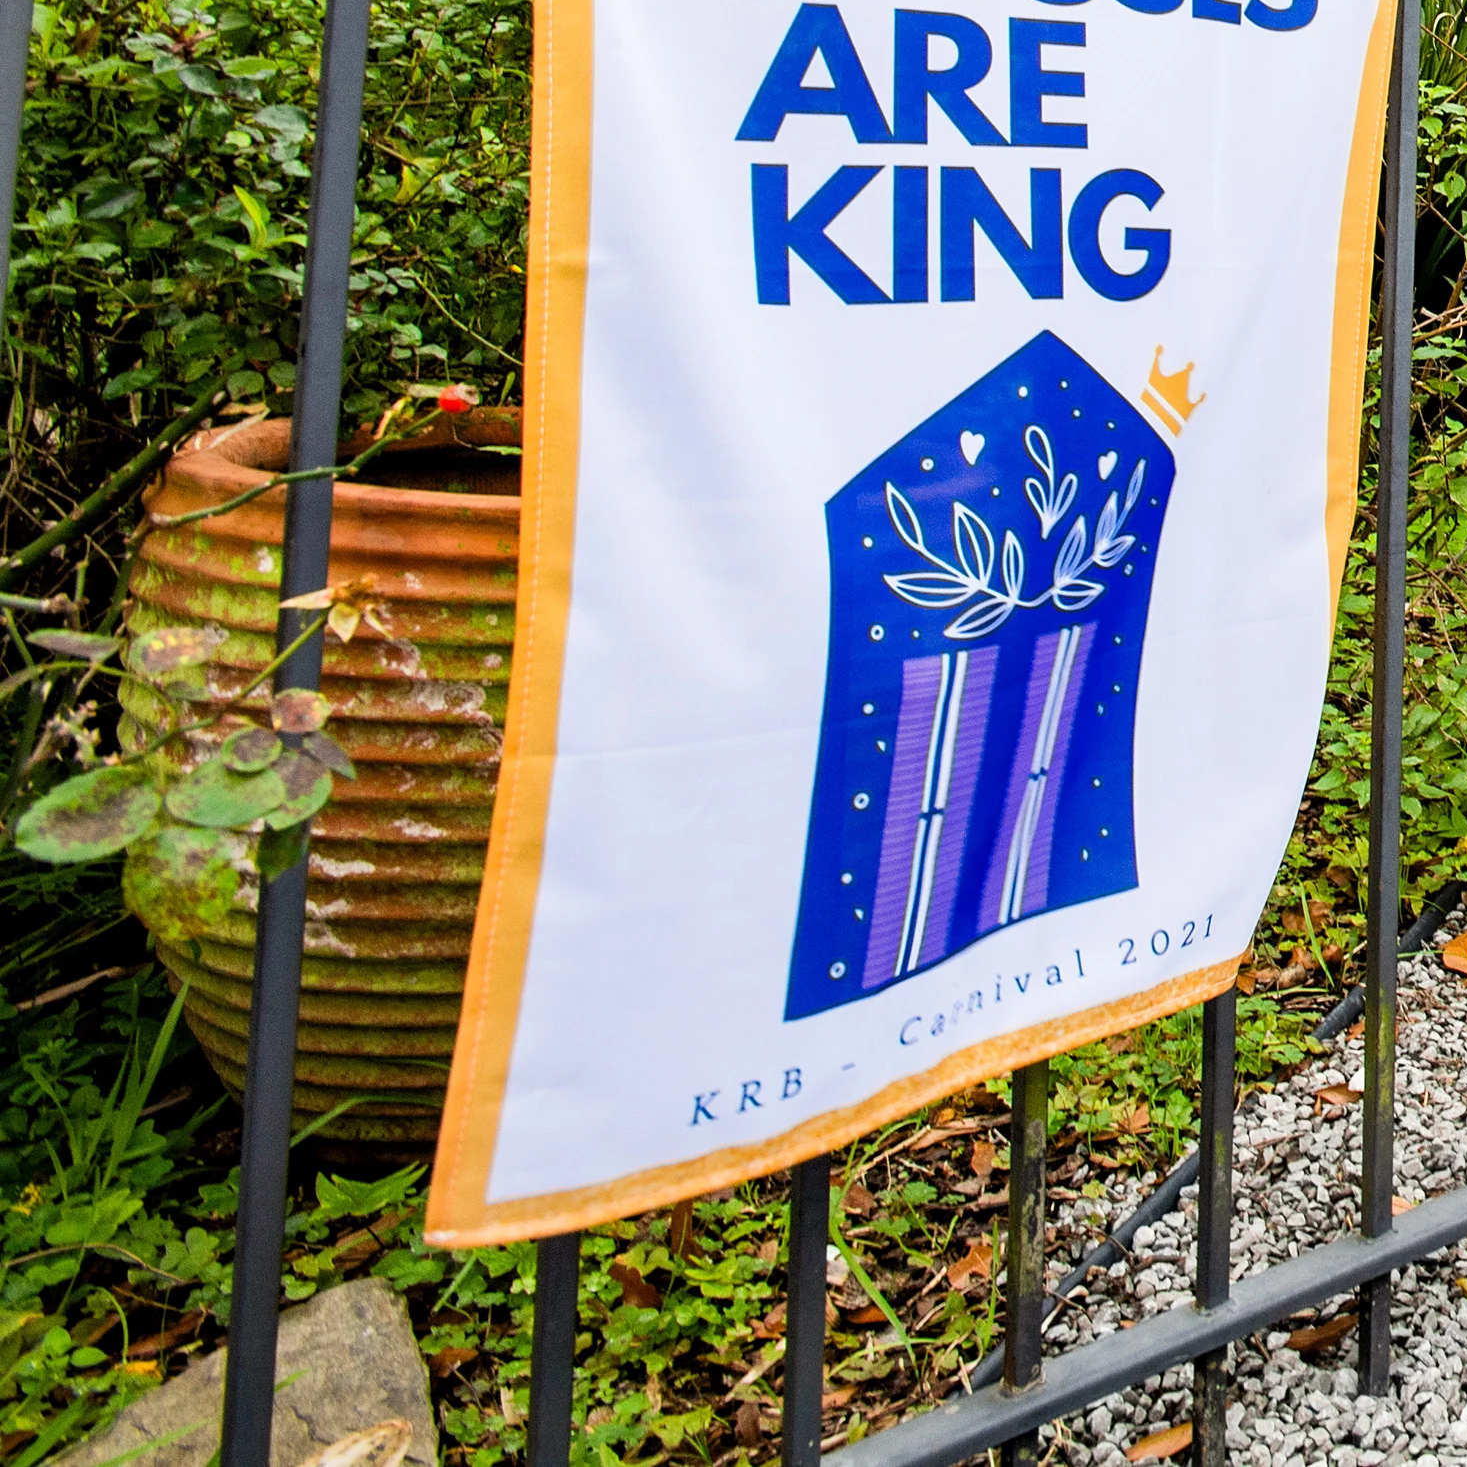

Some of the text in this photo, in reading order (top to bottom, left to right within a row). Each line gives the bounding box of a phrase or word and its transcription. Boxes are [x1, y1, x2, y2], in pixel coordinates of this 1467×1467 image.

[733, 1, 1090, 151] ARE
[748, 161, 1173, 308] KING
[688, 1066, 804, 1128] KRB
[899, 947, 1087, 1048] Carnival
[1117, 913, 1215, 968] 2021
